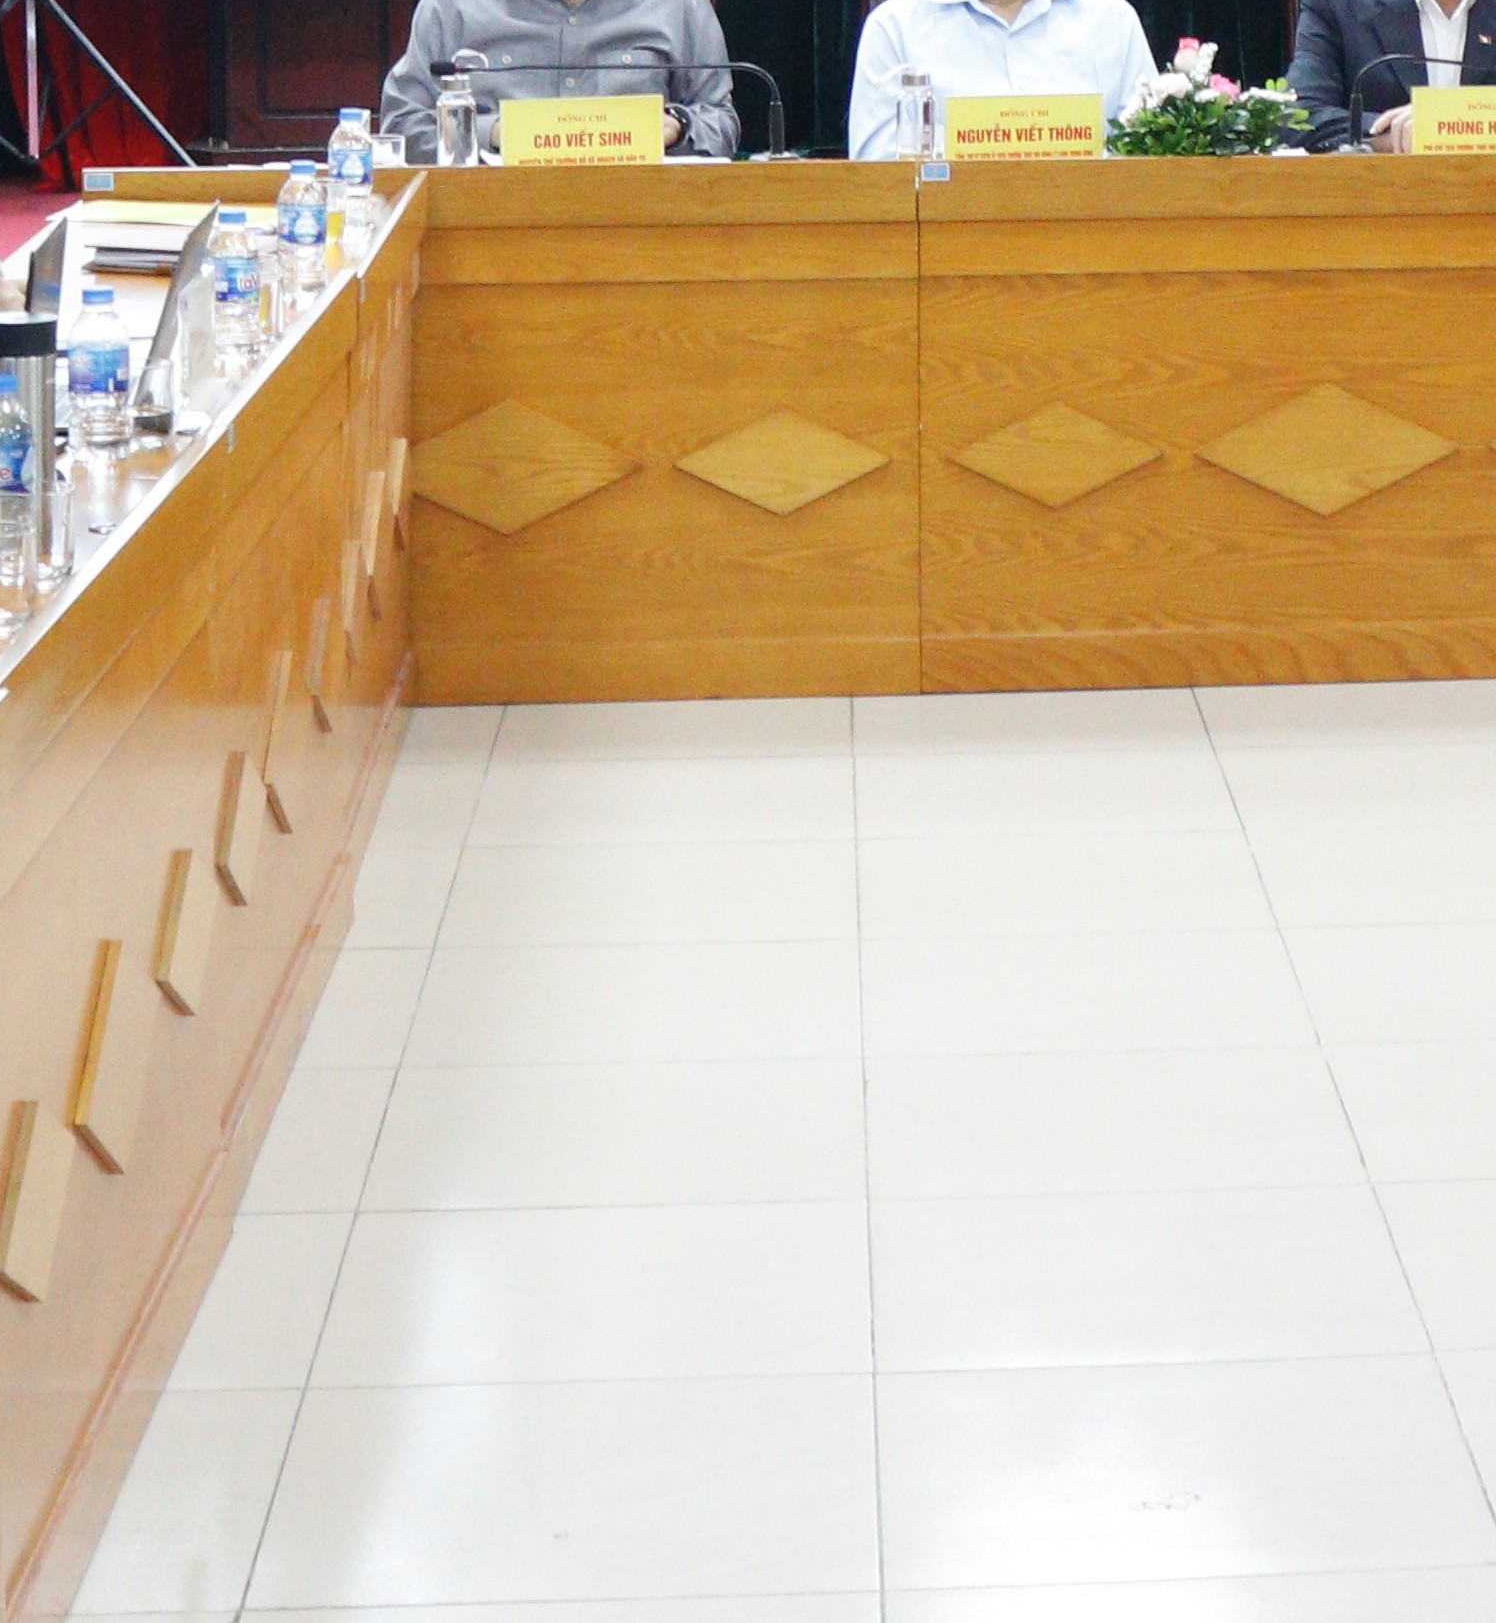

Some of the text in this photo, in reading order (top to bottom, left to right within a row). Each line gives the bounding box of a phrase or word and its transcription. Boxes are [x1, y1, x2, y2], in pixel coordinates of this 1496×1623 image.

[534, 128, 632, 149] CAO VIẾT SINH
[957, 123, 1092, 143] NGUYỄN VIẾT THÔNG
